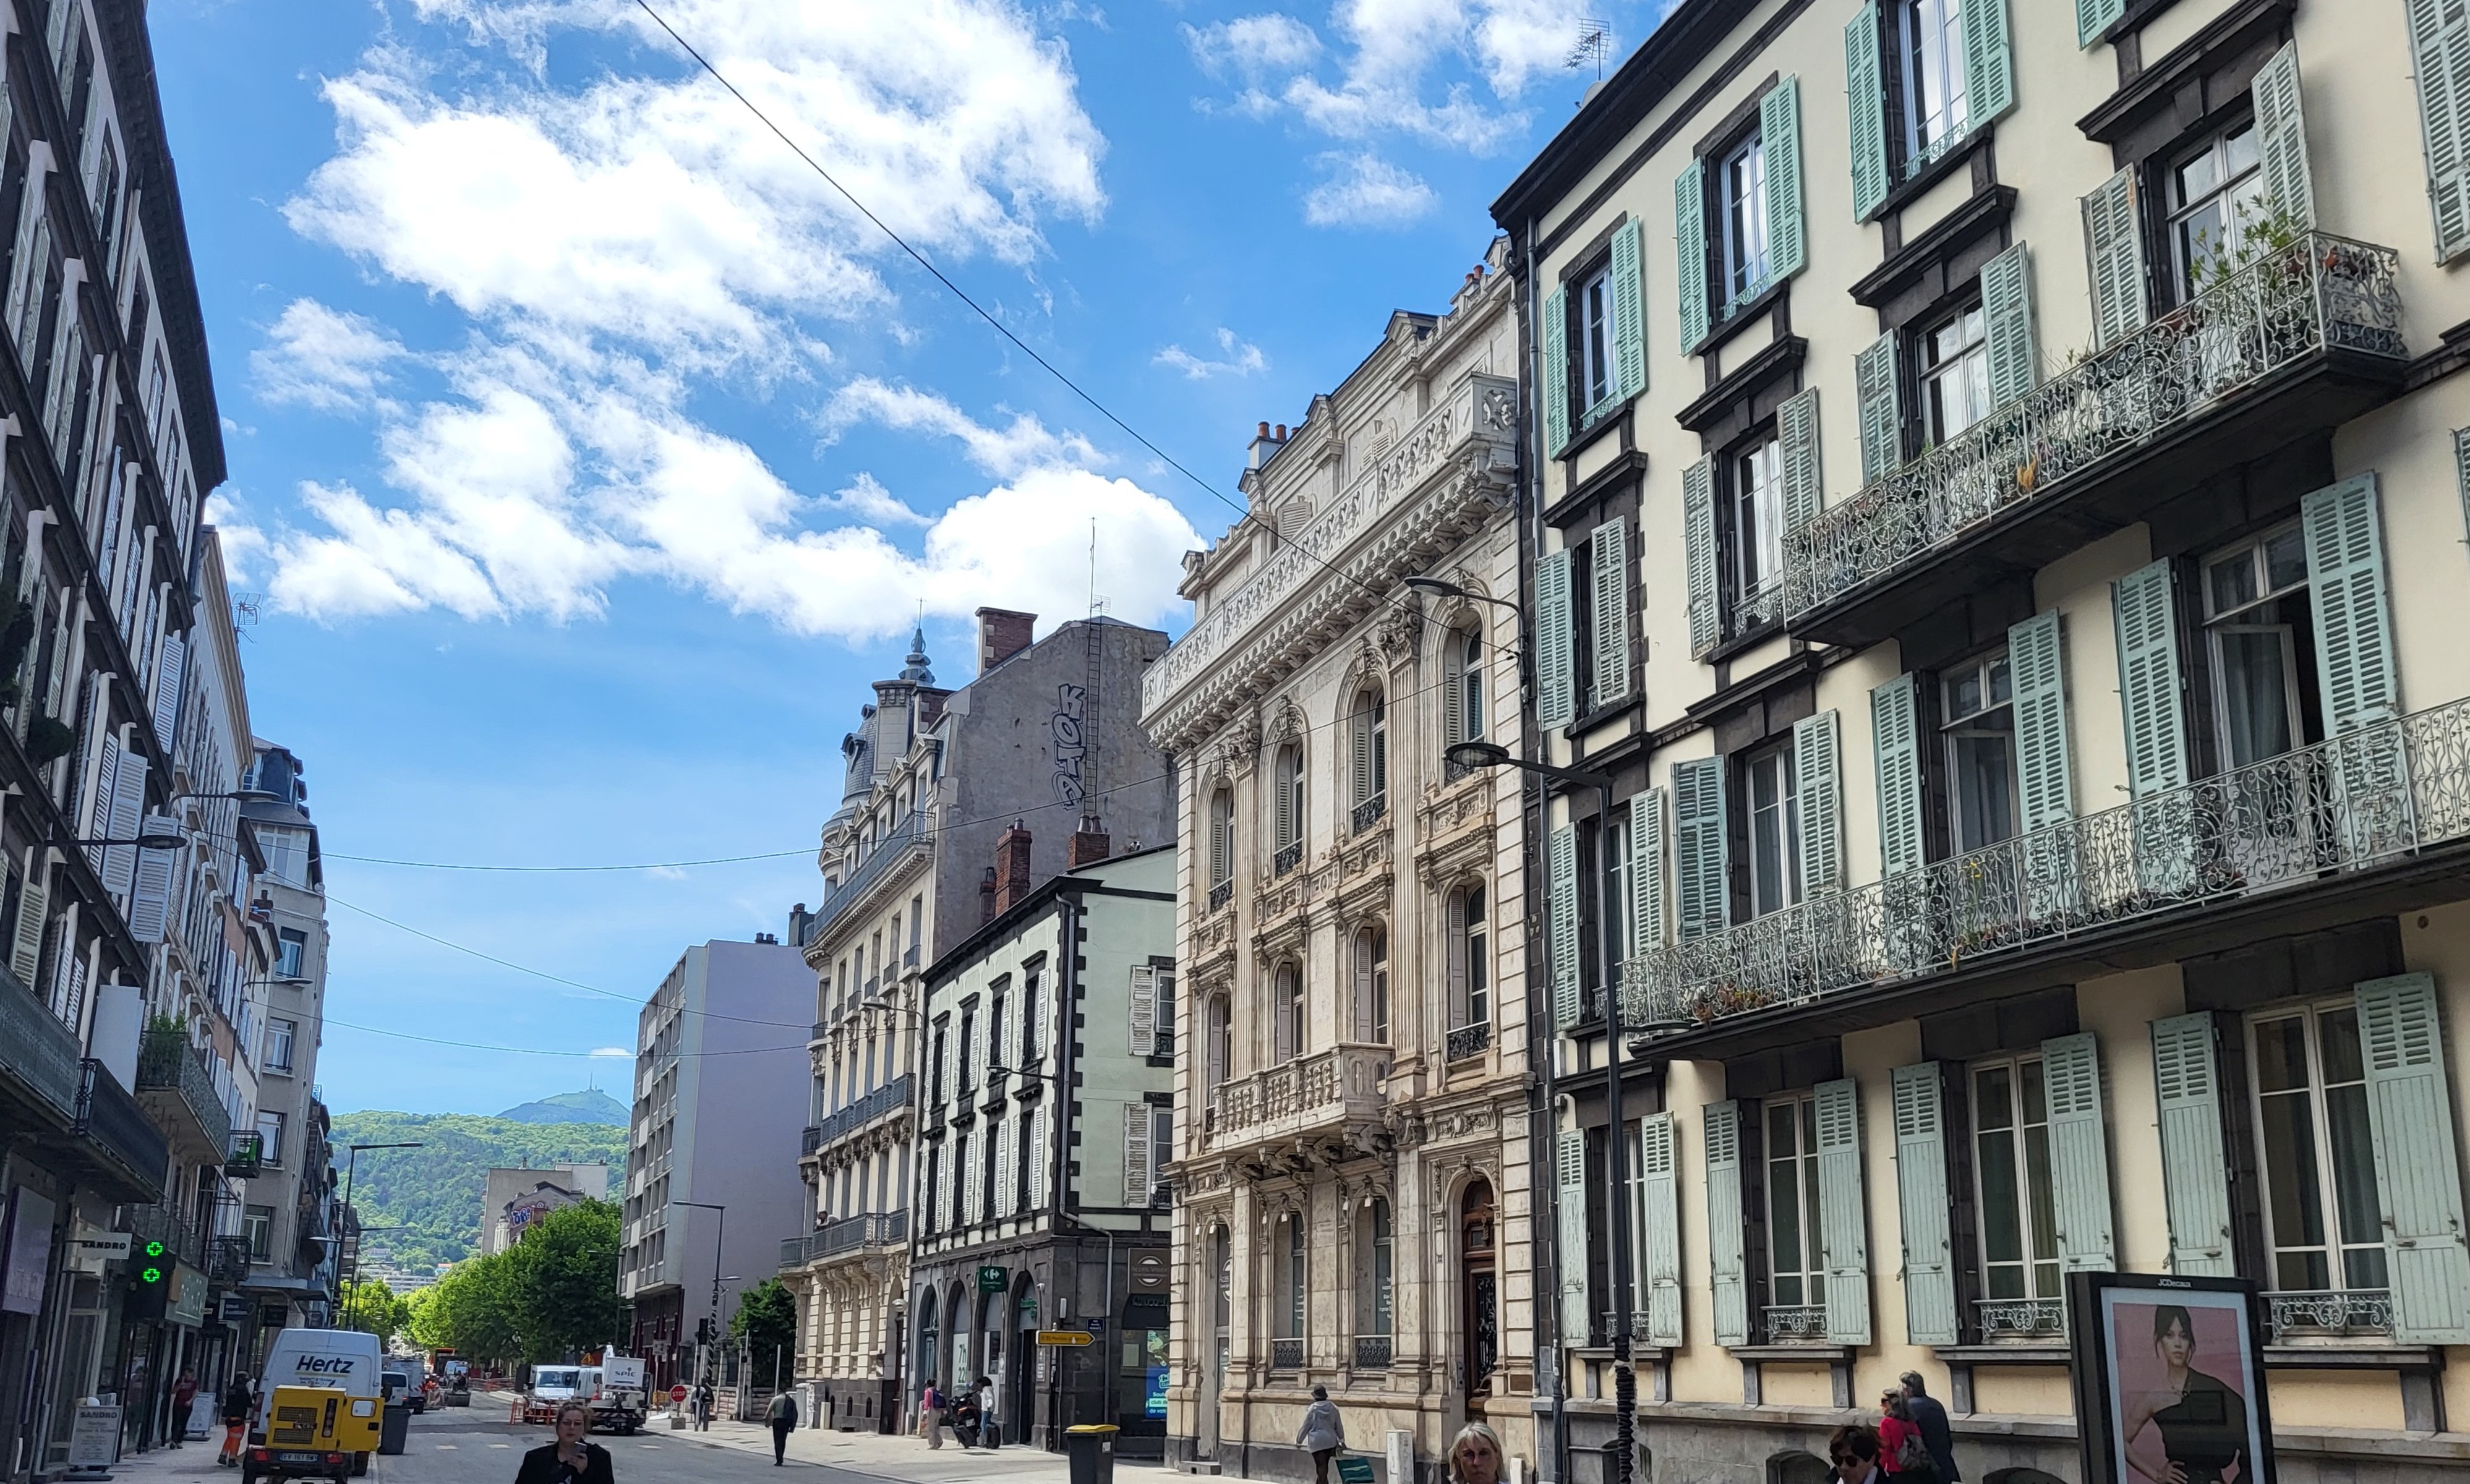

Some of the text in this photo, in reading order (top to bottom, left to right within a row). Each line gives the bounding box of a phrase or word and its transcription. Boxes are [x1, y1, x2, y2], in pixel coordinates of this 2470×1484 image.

[81, 1242, 126, 1250] SANDRO
[296, 1355, 354, 1373] Hertz
[672, 1390, 686, 1398] STOP
